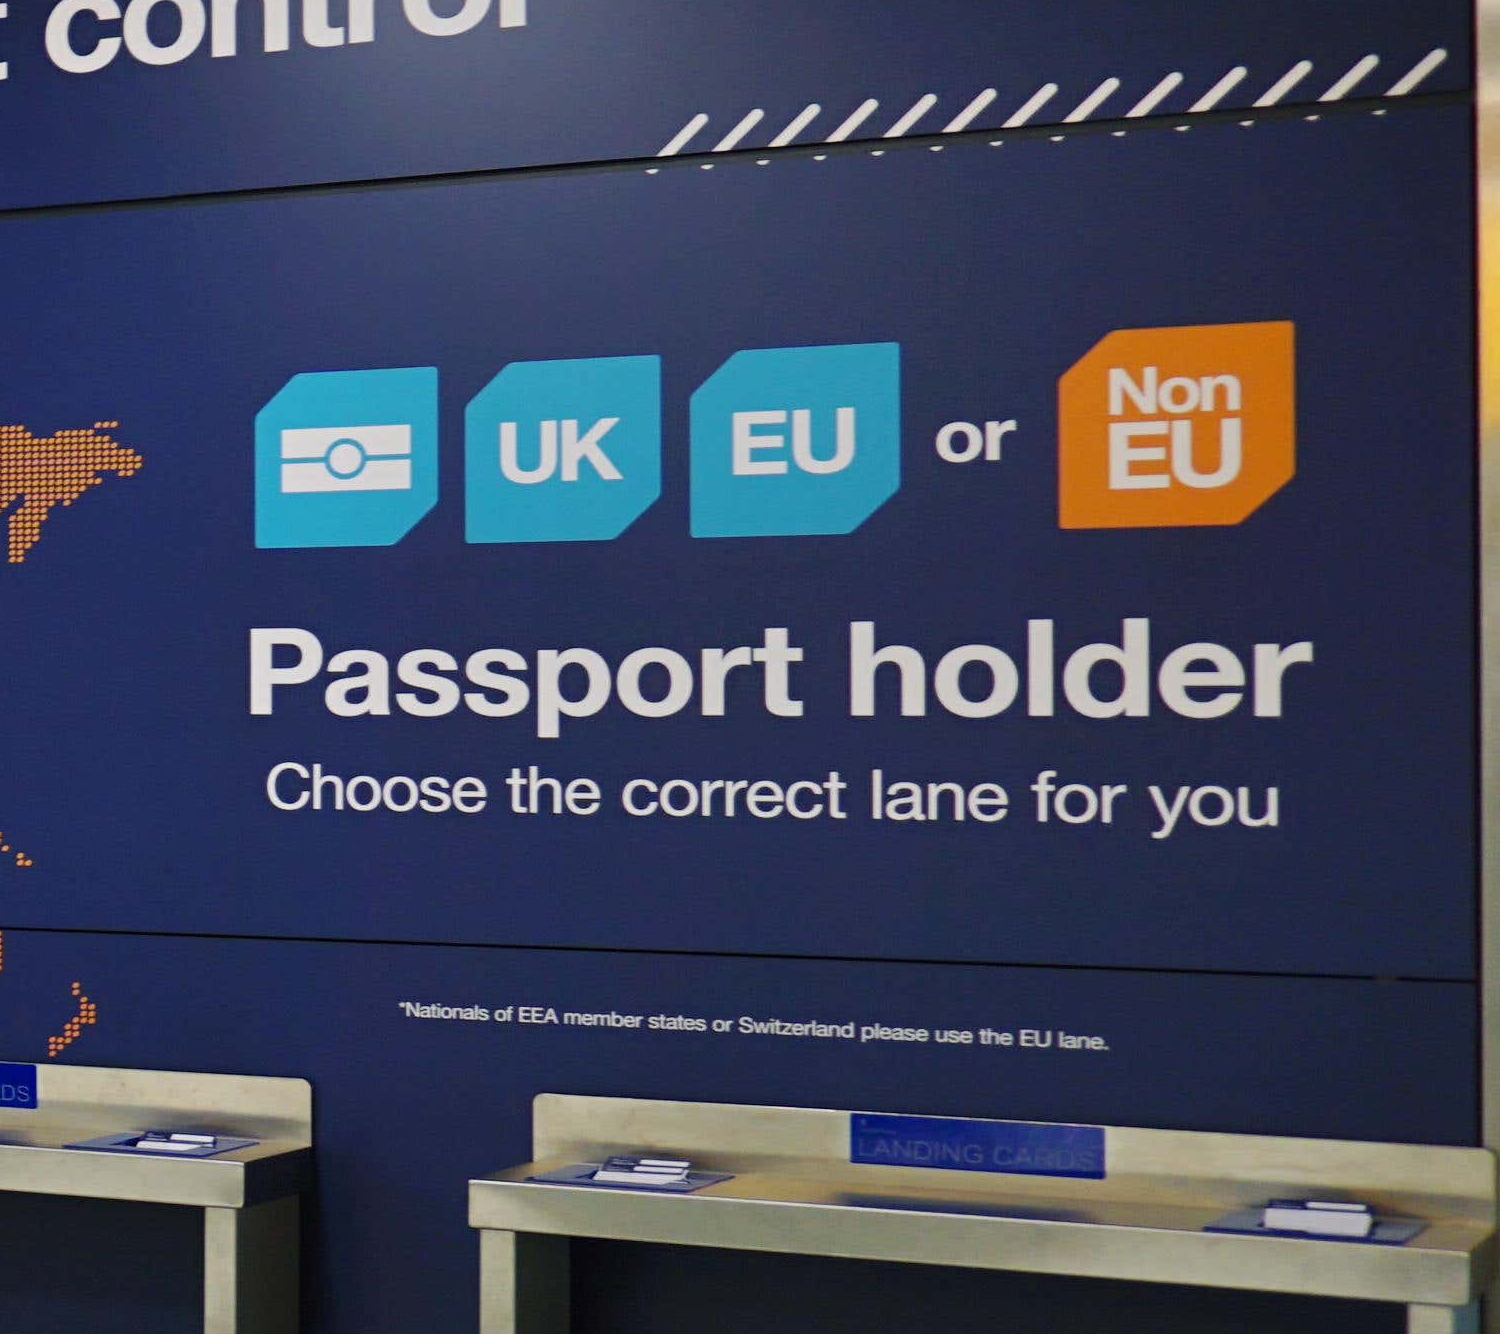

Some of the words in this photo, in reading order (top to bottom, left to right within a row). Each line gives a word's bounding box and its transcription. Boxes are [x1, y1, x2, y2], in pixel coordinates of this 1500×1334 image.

[1106, 365, 1243, 417] Non
[499, 416, 625, 484] UK
[731, 407, 857, 476] EU
[935, 417, 1016, 463] or
[1106, 417, 1243, 491] EU
[248, 627, 804, 738] Passport
[849, 617, 1313, 720] holder
[265, 760, 488, 813] Choose
[506, 765, 602, 817] the
[622, 769, 848, 822] correct
[871, 769, 1009, 824] lane
[1031, 768, 1127, 826] for
[1148, 777, 1281, 840] you
[494, 1005, 513, 1022] of
[518, 1006, 559, 1024] EEA
[563, 1010, 644, 1029] member
[647, 1013, 706, 1031] states
[711, 1018, 734, 1033] or
[738, 1017, 855, 1039] Switzerland
[861, 1023, 929, 1043] please
[935, 1028, 973, 1044] use
[978, 1028, 1013, 1046] the
[1019, 1029, 1052, 1047] EU
[1058, 1031, 1110, 1051] lane.
[858, 1138, 985, 1165] LANDING
[992, 1145, 1096, 1171] CARDS
